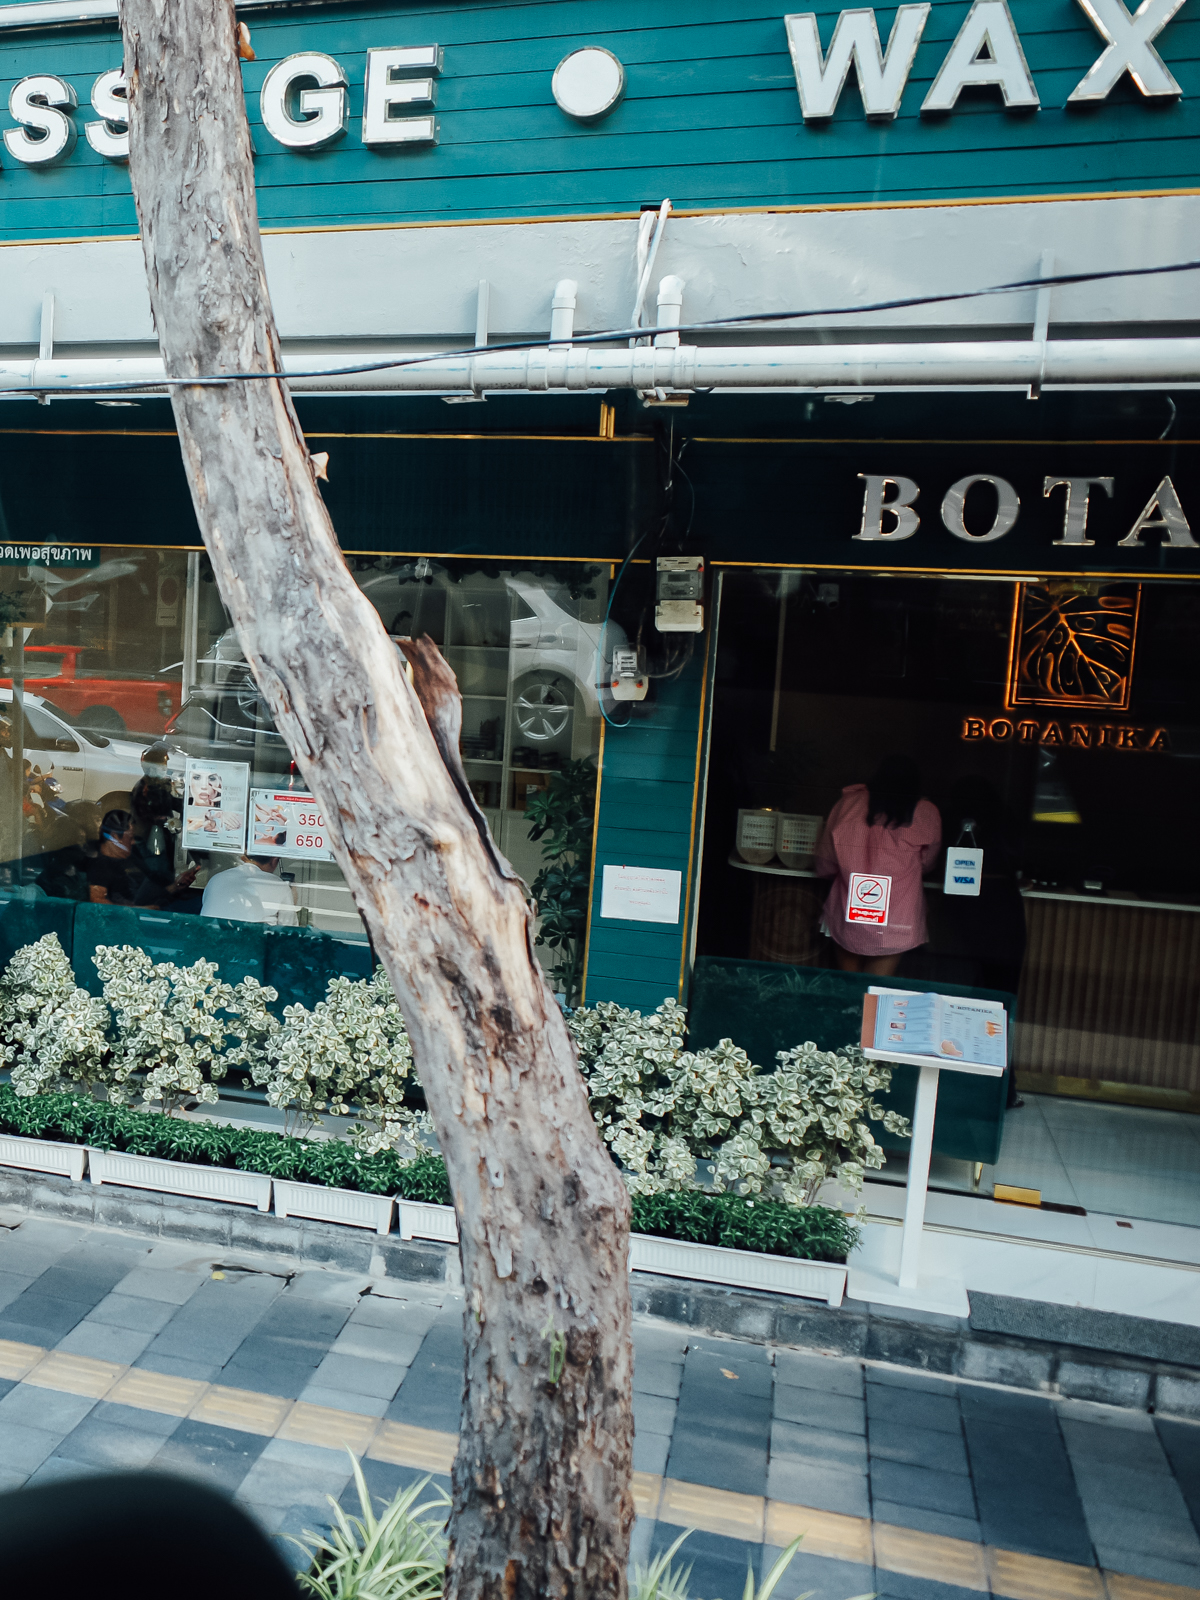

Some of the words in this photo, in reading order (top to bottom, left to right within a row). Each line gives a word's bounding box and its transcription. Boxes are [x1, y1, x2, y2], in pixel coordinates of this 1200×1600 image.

[784, 0, 1185, 121] WAX
[852, 473, 1200, 547] BOTA
[962, 717, 1171, 751] BOTANIKA
[298, 813, 326, 828] 350
[295, 834, 324, 849] 650
[954, 859, 976, 867] OPEN
[953, 876, 975, 885] VISA
